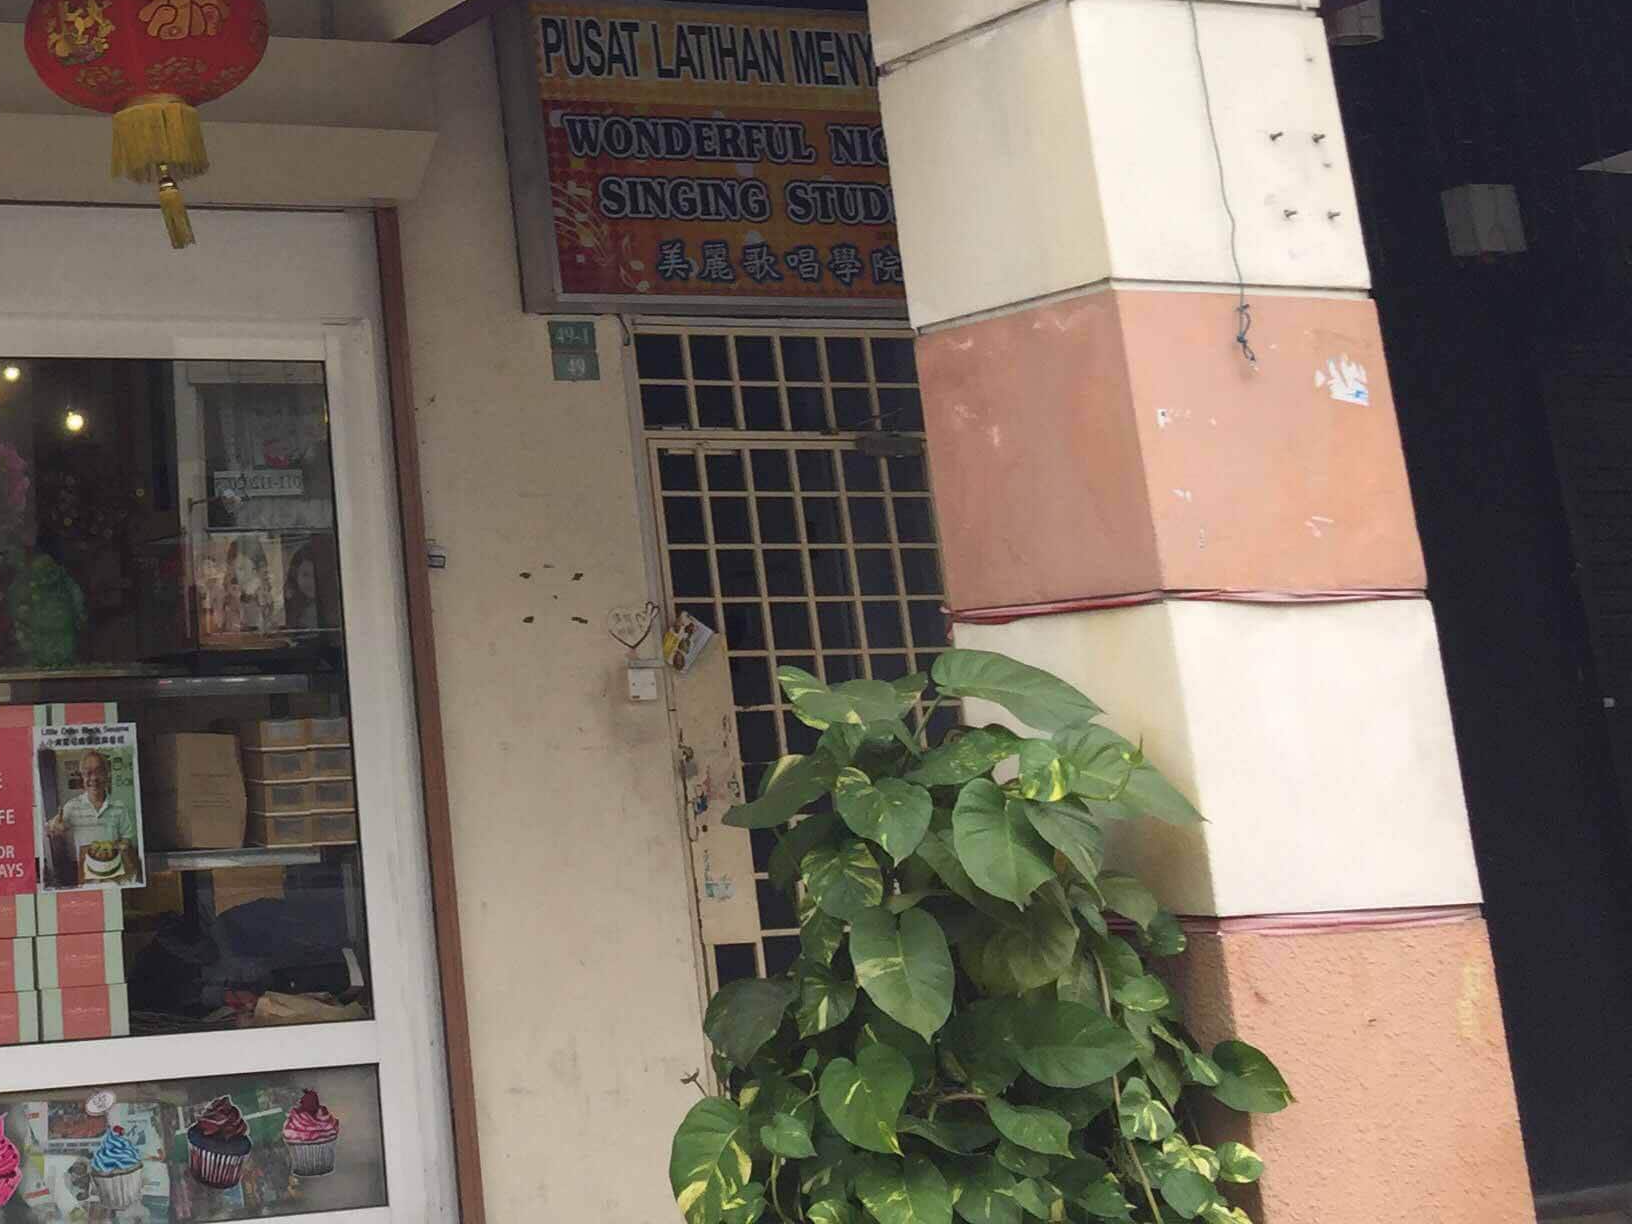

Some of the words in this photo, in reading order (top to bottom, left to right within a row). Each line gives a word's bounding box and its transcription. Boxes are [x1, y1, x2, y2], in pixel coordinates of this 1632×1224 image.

[539, 16, 640, 78] PUSAT
[650, 22, 786, 84] LATIHAN
[562, 115, 816, 164] WONDERFUL
[598, 177, 769, 223] SINGING
[784, 181, 897, 225] STUD
